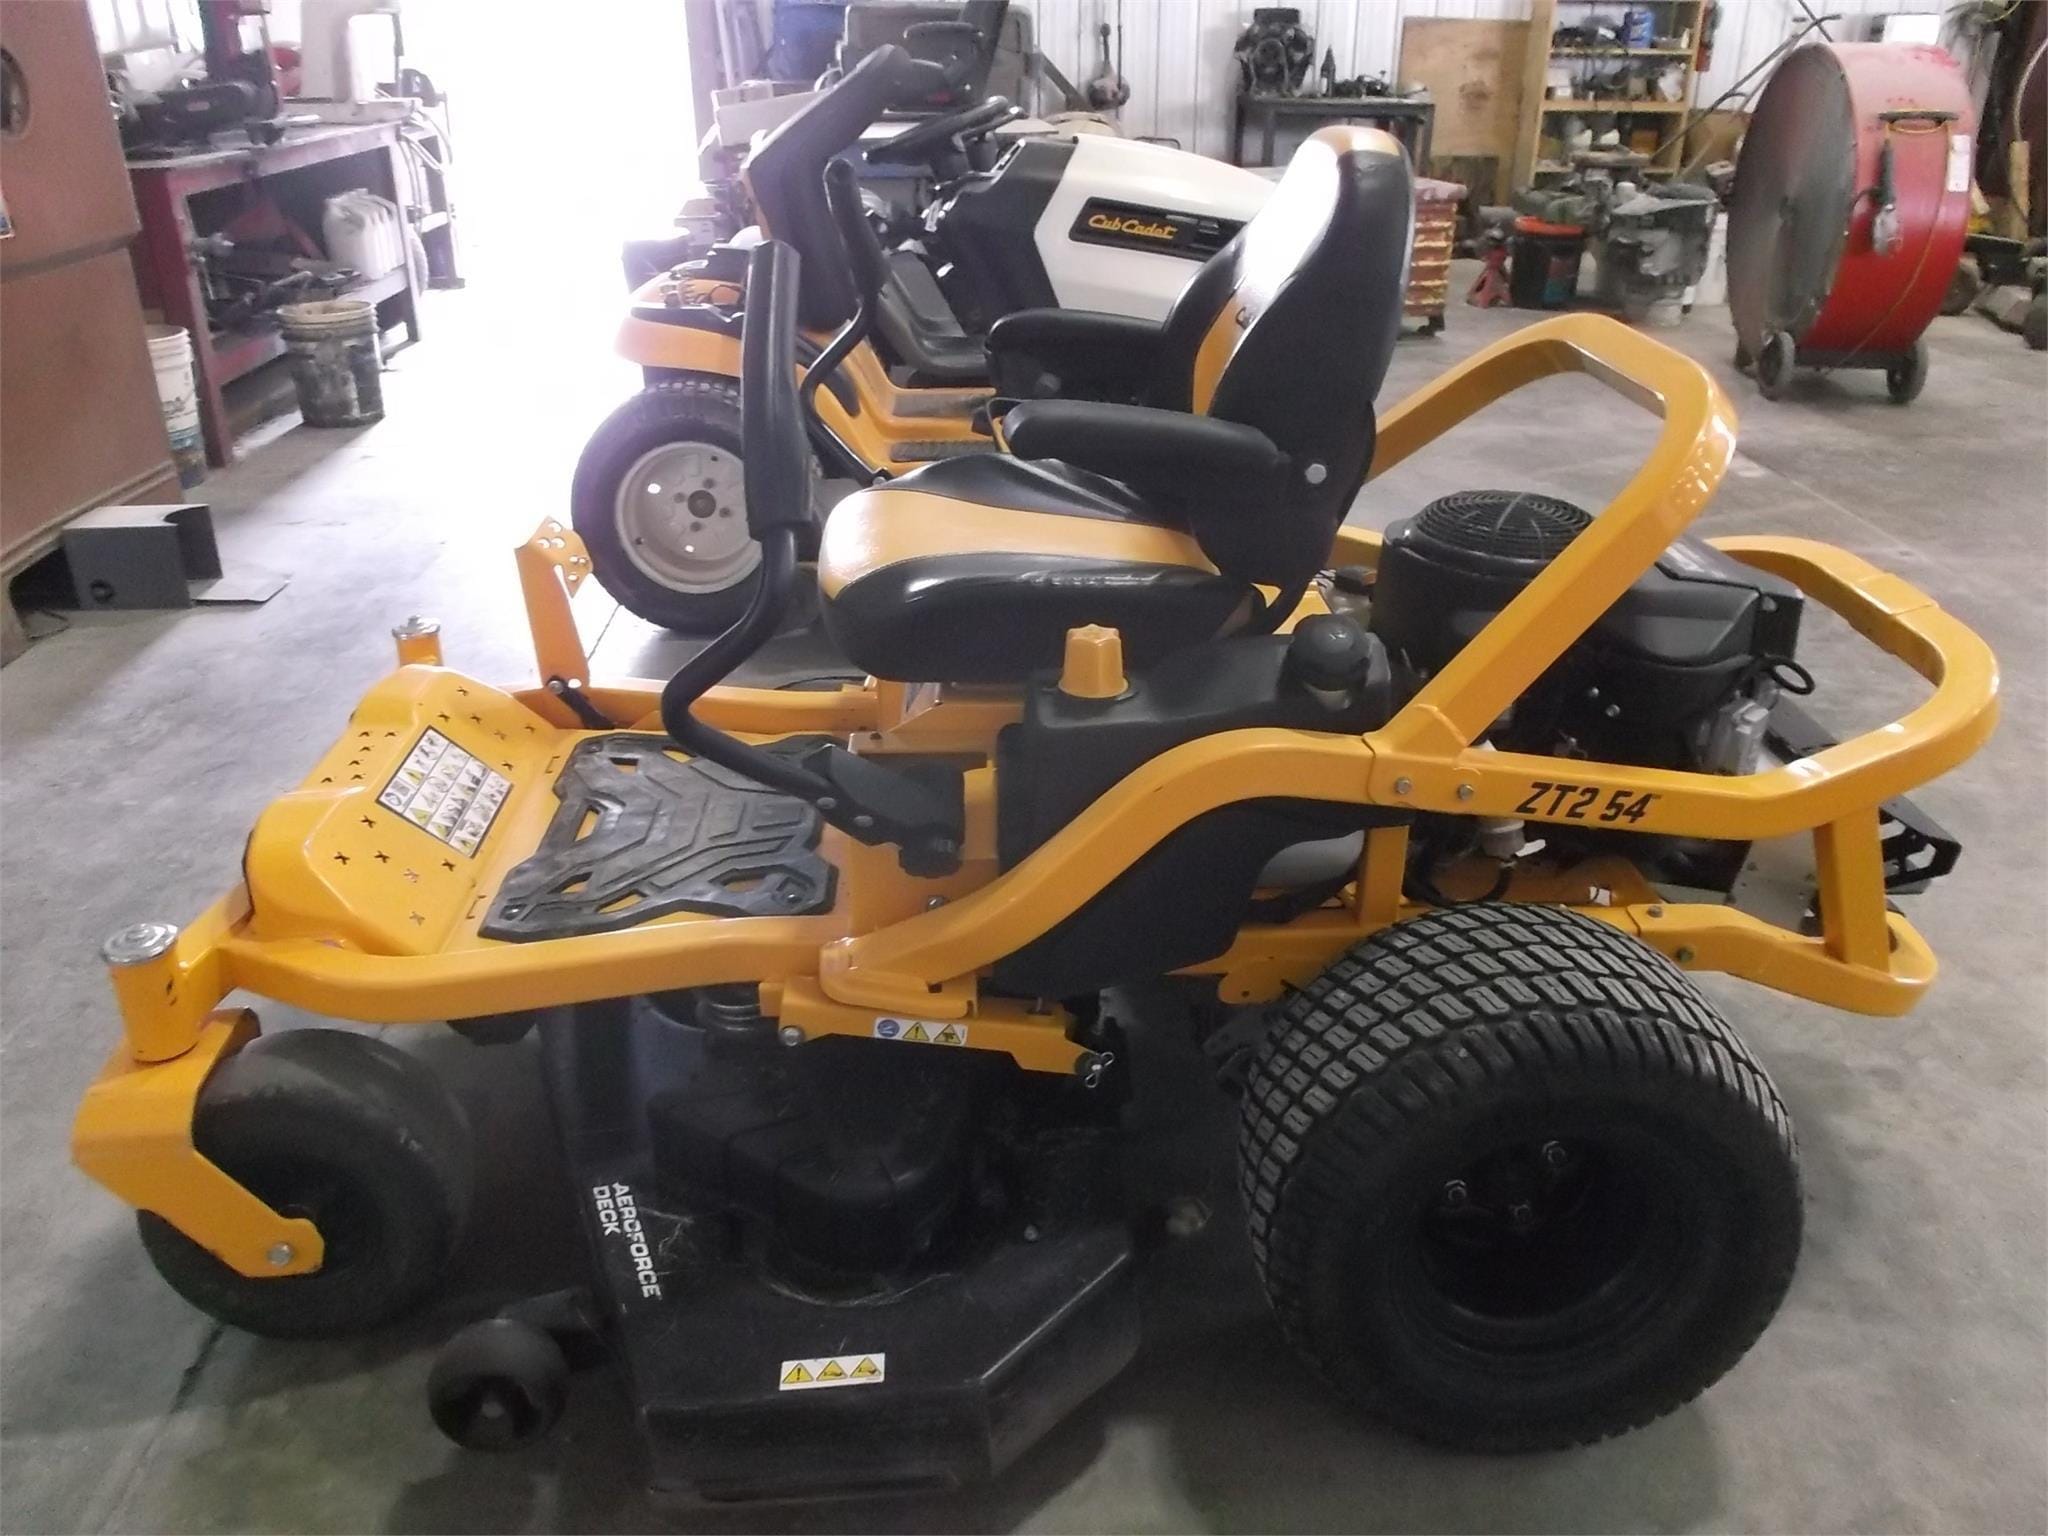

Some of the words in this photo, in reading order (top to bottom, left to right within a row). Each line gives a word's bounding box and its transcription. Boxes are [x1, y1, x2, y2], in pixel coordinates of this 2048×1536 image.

[1088, 214, 1122, 231] Cub
[1121, 219, 1178, 240] Cadet
[1514, 781, 1599, 819] ZT2
[592, 1184, 622, 1237] DECK
[611, 1181, 662, 1299] AEROFORCE
